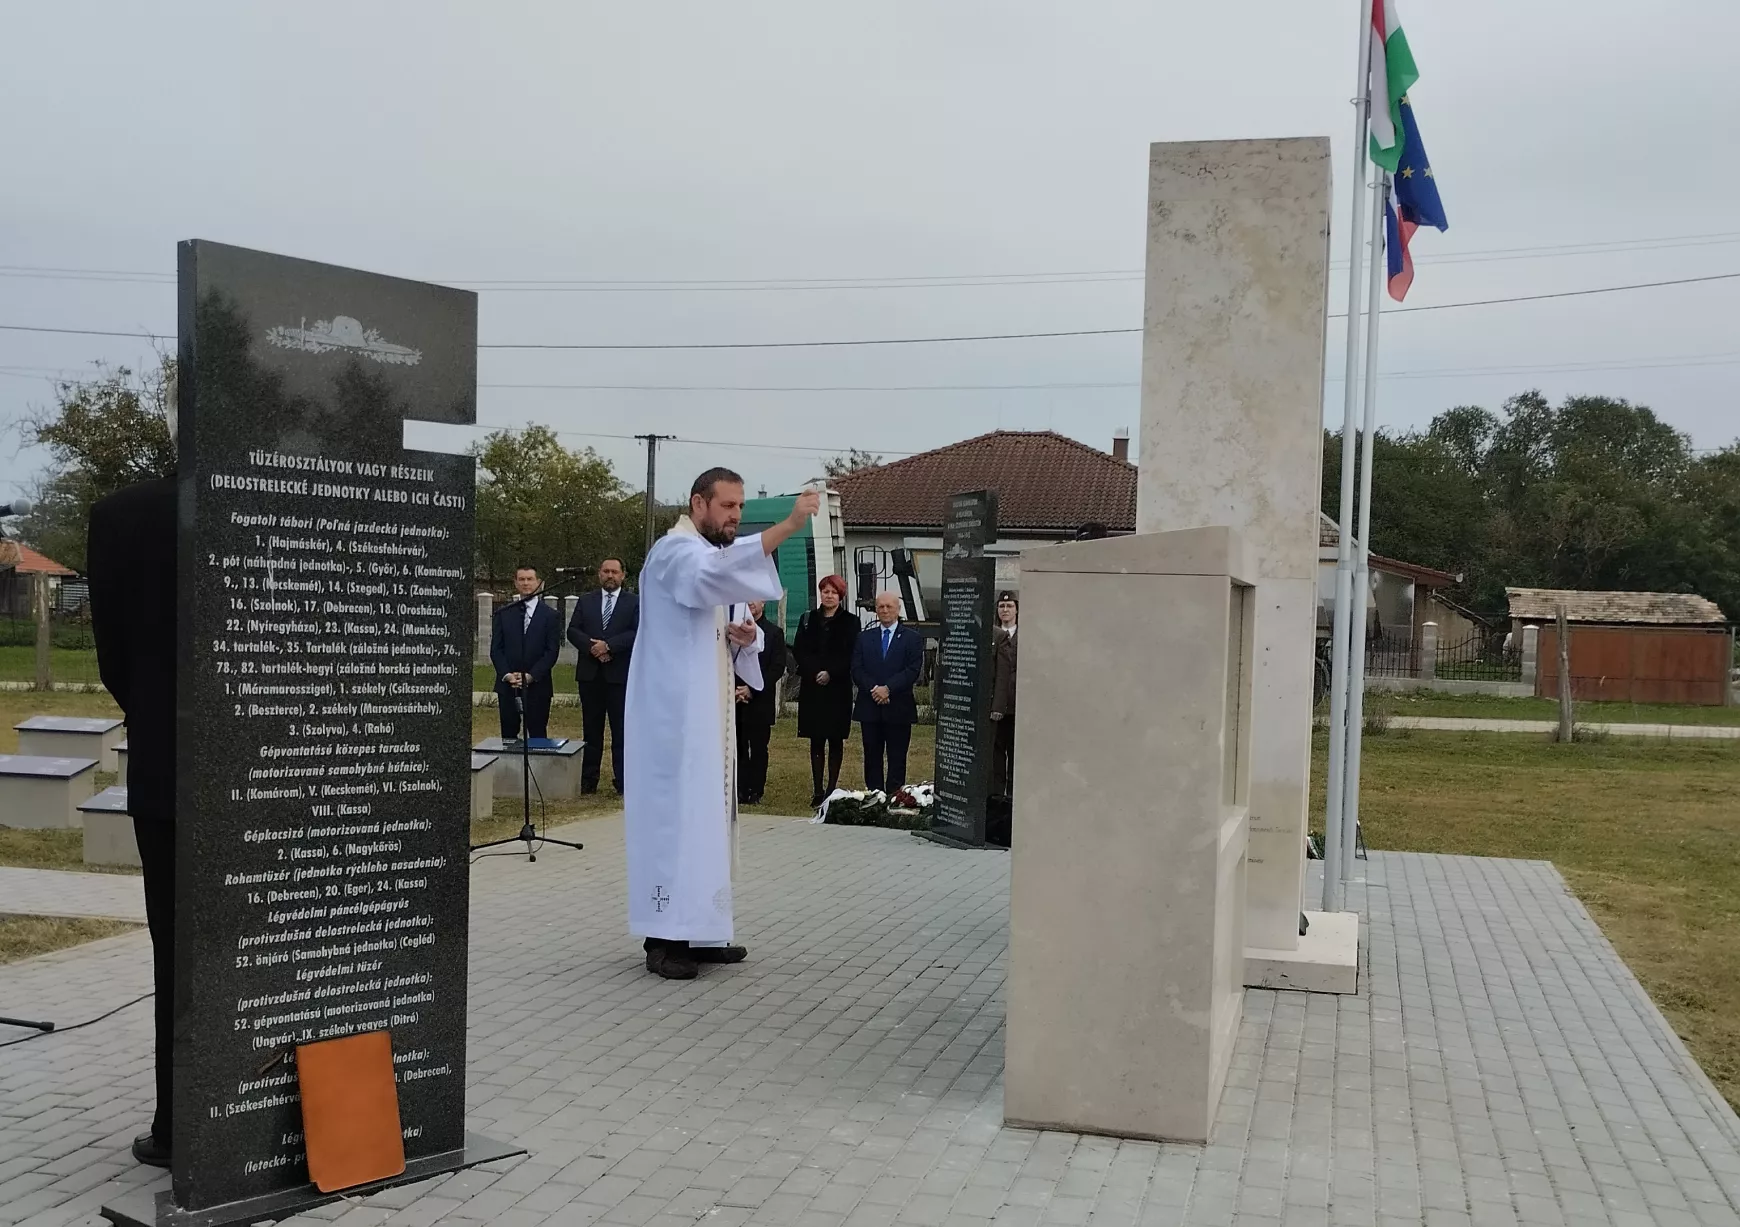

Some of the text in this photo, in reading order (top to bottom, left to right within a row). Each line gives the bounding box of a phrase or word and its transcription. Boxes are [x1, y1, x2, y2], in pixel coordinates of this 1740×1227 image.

[249, 450, 434, 482] TÜZÉROSZTÁLYOK VAGY RÉSZEIK
[210, 473, 466, 510] (DELOSTRELECKÉ JEDNOTKY ALEBO ICH ČASTI)
[231, 511, 450, 540] Fogatolt tábori (Poľná jazdecká jednotka):
[255, 535, 428, 558] 1. (Hajmáskér), 4. (Székesfehérvár),
[209, 553, 219, 566] 2.
[223, 555, 241, 570] pót
[299, 558, 353, 573] jednotka)-,
[356, 562, 366, 573] 5.
[368, 561, 400, 576] (Győr),
[402, 564, 412, 575] 6.
[414, 564, 466, 580] (Komárom),
[224, 576, 239, 590] 9.,
[242, 577, 259, 589] 13.
[328, 581, 344, 593] 14.
[346, 581, 391, 596] (Szeged),
[392, 584, 408, 595] 15.
[410, 584, 453, 599] (Zombor),
[230, 598, 448, 618] 16. (Szolnok), 17. (Debrecen), 18. (Orosháza),
[226, 619, 451, 637] 22. (Nyíregyháza), 23. (Kassa), 24. (Munkács),
[212, 640, 230, 652] 34.
[233, 641, 284, 654] tartalék-,
[286, 641, 303, 653] 35.
[306, 642, 347, 654] Tartalék
[349, 642, 389, 655] (záložná
[391, 643, 441, 656] jednotka)-,
[216, 661, 458, 676] 78., 82. tartalék-hegyi (záložná horská jednotka):
[224, 682, 451, 698] 1. (Máramarossziget), 1. székely (Csíkszereda),
[234, 701, 443, 718] 2. (Beszterce), 2. székely (Marosvásárhely),
[288, 723, 395, 738] 3. (Szolyva), 4. (Rahó)
[260, 741, 420, 760] Gépvontatású közepes tarackos
[248, 761, 430, 781] (motorizované samohybné húfnice):
[231, 780, 443, 802] II. (Komárom), V. (Kecskemét), VI. (Szolnok),
[311, 803, 371, 818] VIII. (Kassa)
[244, 818, 432, 843] Gépkocsizó (motorizovaná jednotka):
[277, 849, 288, 861] 2.
[290, 846, 329, 861] (Kassa),
[332, 844, 342, 855] 6.
[225, 870, 290, 886] Rohamtüzér
[293, 865, 343, 882] (jednotka
[391, 856, 447, 872] nasadenia):
[247, 877, 427, 905] 16. (Debrecen), 20. (Eger), 24. (Kassa)
[267, 898, 410, 925] Légvédelmi páncélgépágyús
[238, 915, 434, 949] (protivzdušná delostrelecká jednotka):
[235, 933, 436, 969] 52. önjáró (Samohybná jednotka) (Cegléd)
[296, 959, 383, 982] Légvédelmi tüzér
[237, 972, 433, 1012] (protivzdušná delostrelecká jednotka):
[234, 989, 435, 1031] 52. gépvontatású (motorizovaná jednotka)
[390, 1011, 419, 1028] (Ditró)
[209, 1106, 222, 1119] II.
[403, 1063, 452, 1083] (Debrecen),
[244, 1155, 291, 1176] (letecká-
